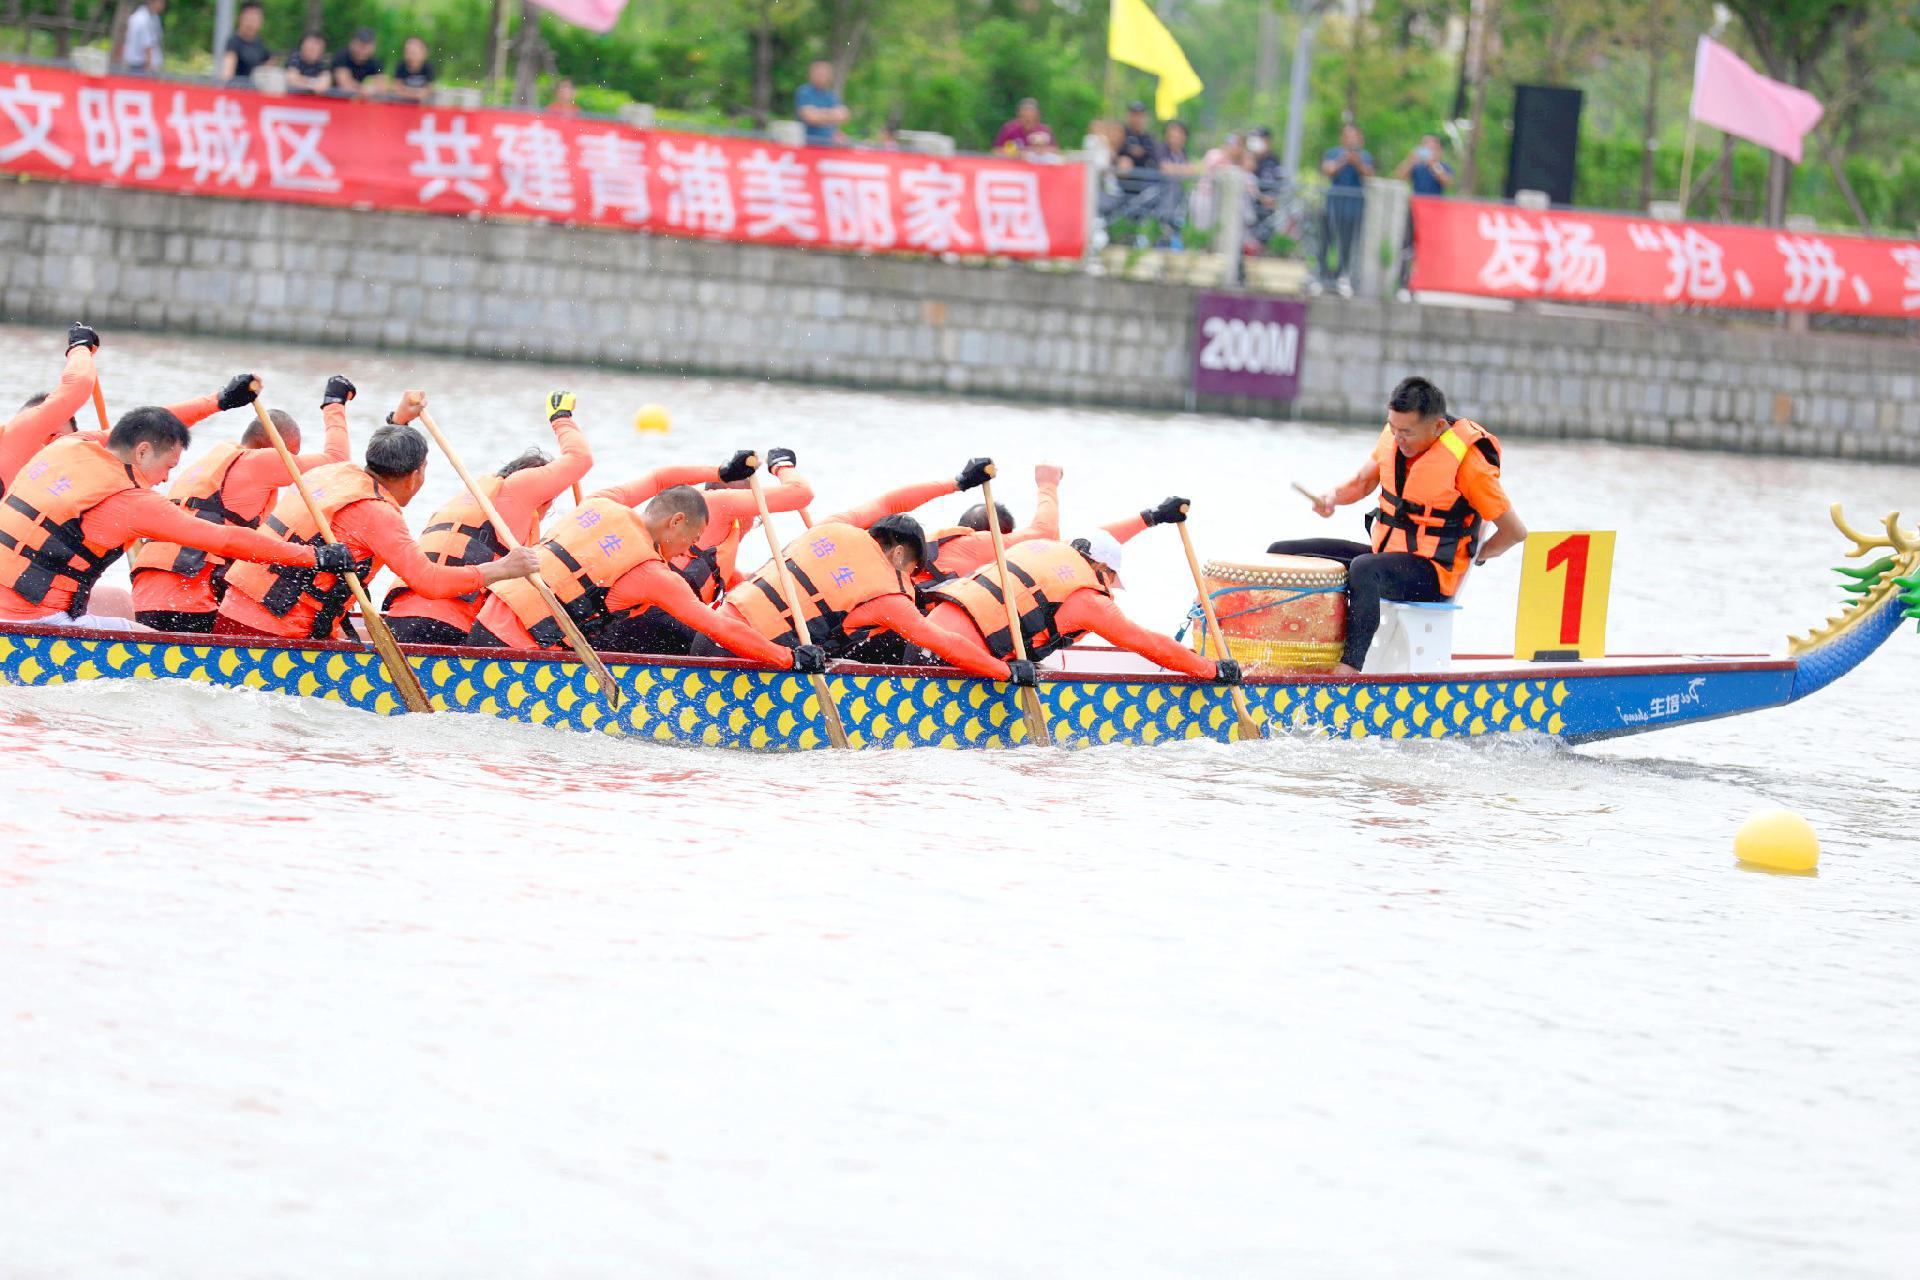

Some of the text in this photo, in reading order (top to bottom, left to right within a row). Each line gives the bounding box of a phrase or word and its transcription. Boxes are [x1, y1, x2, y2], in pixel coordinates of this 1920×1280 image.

[0, 74, 1050, 254] 文明城区 共建青浦美丽家园
[1200, 316, 1299, 376] 200M
[1546, 534, 1591, 645] 1
